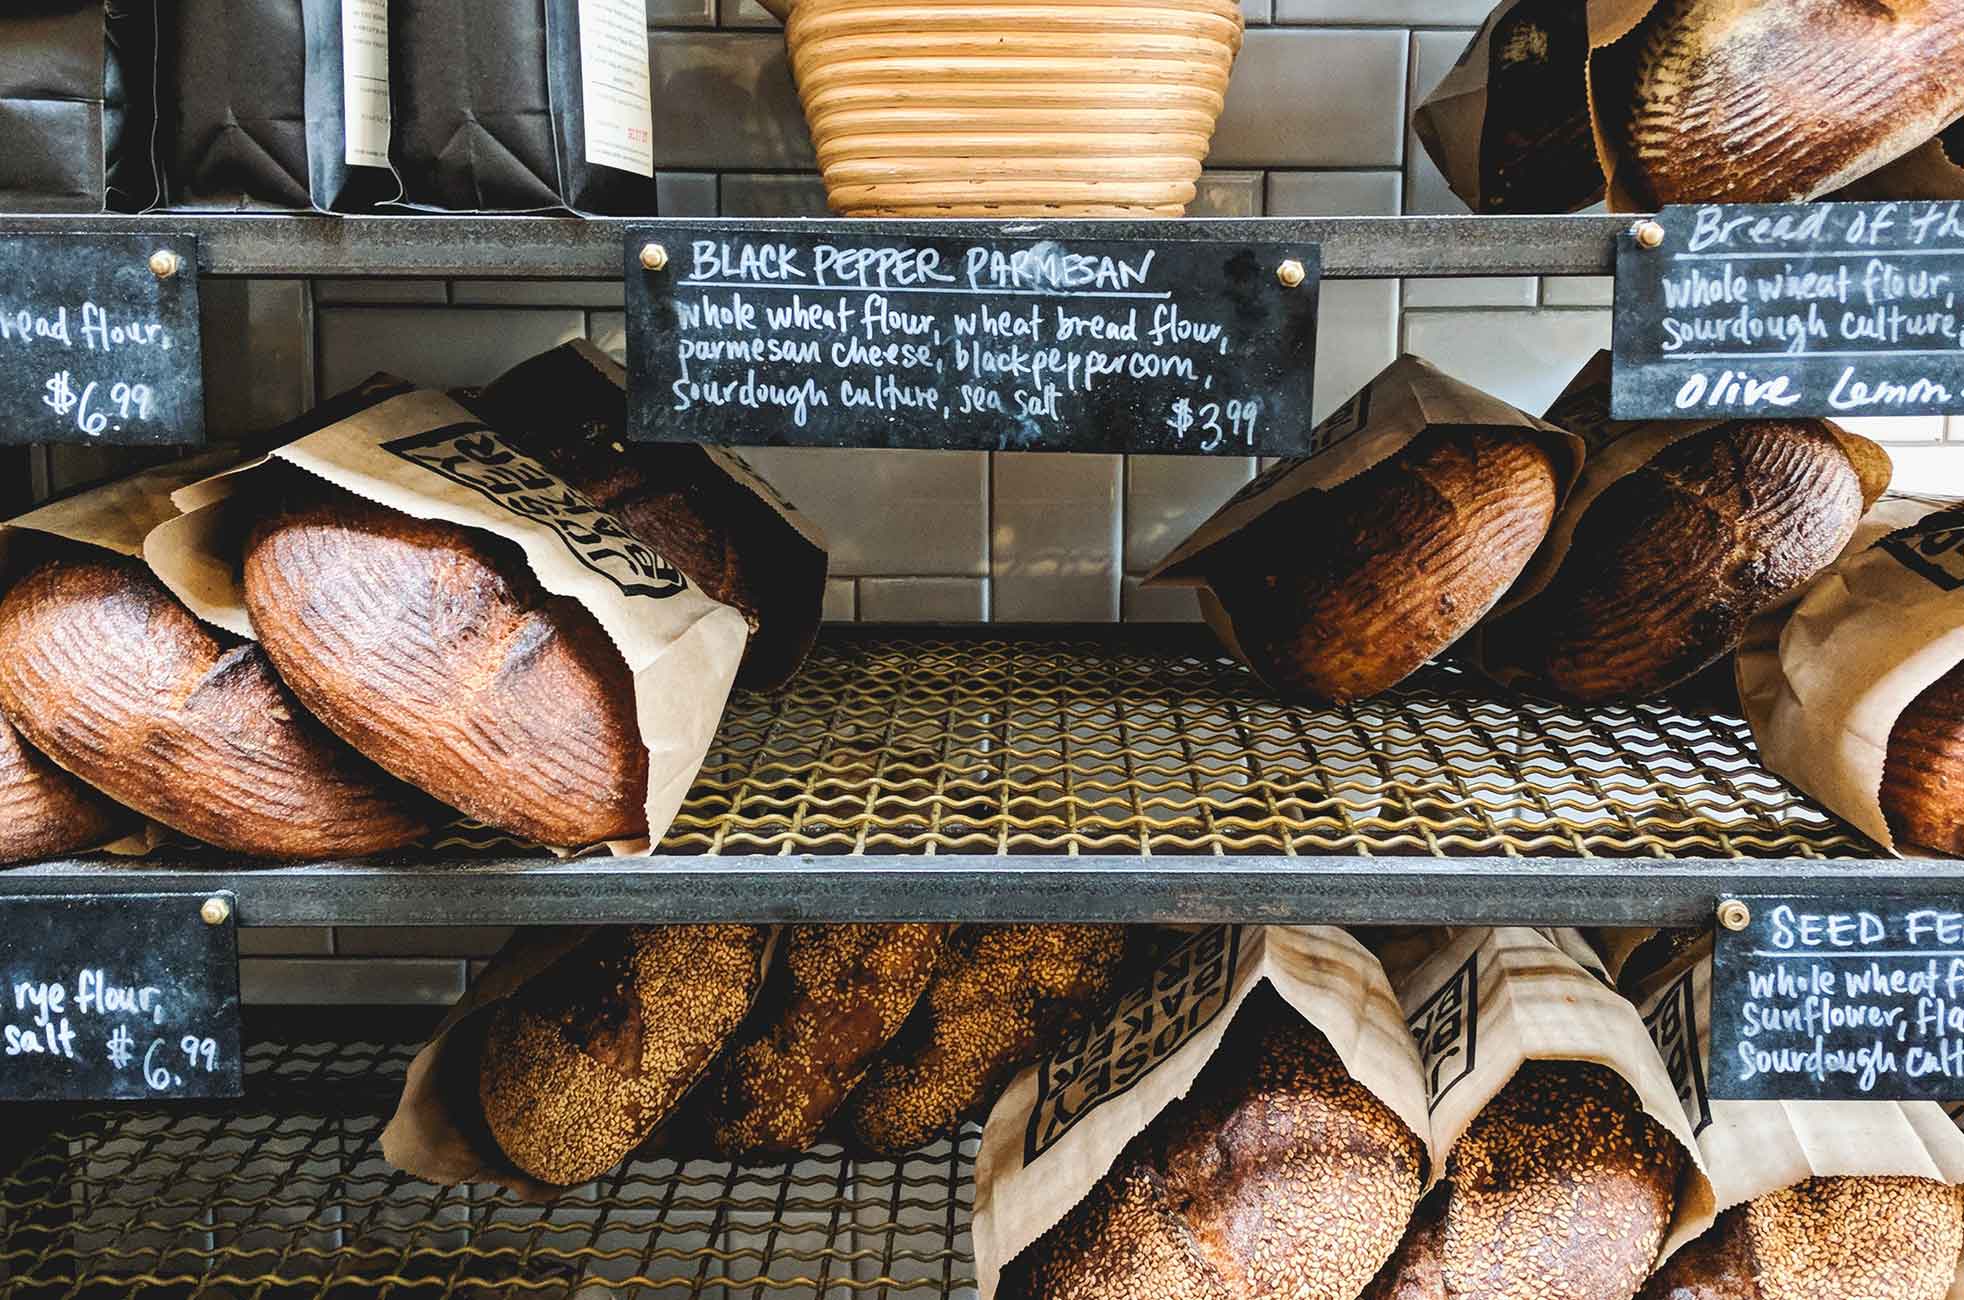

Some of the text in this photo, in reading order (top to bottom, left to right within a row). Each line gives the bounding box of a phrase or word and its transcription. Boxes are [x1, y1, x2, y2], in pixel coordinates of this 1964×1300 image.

[1688, 203, 1832, 251] Bread
[1846, 204, 1898, 245] of
[689, 240, 1155, 291] BLACK PEPPER PARMESAN
[1758, 264, 1851, 304] wheat
[1863, 258, 1954, 309] flour,
[81, 301, 173, 351] flour,
[766, 294, 856, 333] wheat
[860, 293, 941, 346] flour,
[954, 304, 1044, 341] wheat
[1057, 306, 1138, 342] bread
[1148, 303, 1228, 355] flour,
[679, 338, 822, 381] parmesan
[832, 336, 942, 373] cheese,
[840, 374, 949, 419] culture,
[960, 384, 1002, 414] sea
[1014, 383, 1063, 421] salt
[1675, 367, 1951, 409] Olive Lemon
[411, 453, 641, 576] JOSEY
[1772, 905, 1964, 949] SEED FE
[14, 969, 161, 1027] rye flour,
[1845, 959, 1939, 998] wheat
[4, 1017, 76, 1058] salt
[1047, 954, 1222, 1100] BAKER
[1042, 986, 1221, 1142] JOSEY
